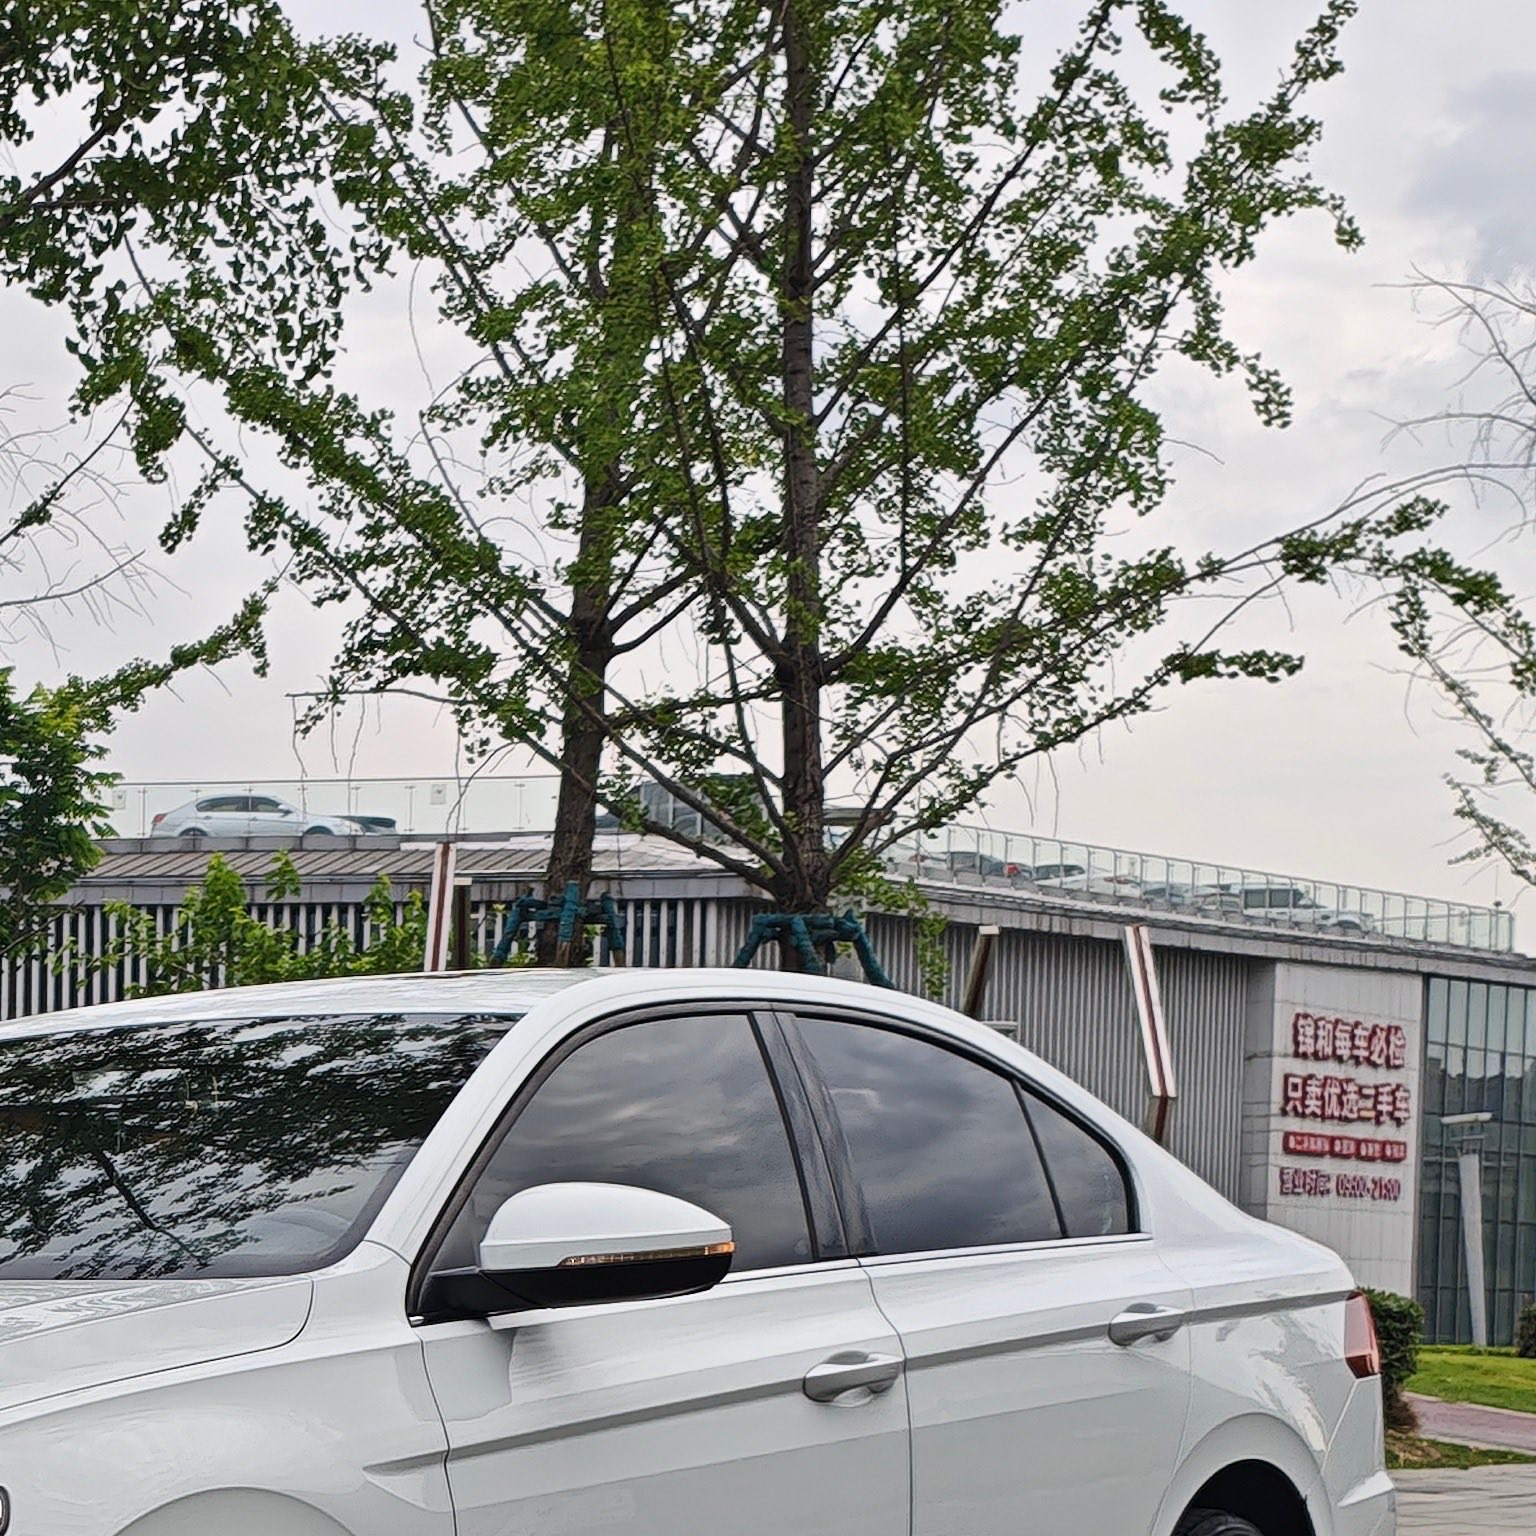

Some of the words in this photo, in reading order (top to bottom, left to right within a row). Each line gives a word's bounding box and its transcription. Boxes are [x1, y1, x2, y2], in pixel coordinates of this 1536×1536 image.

[1282, 1073, 1410, 1127] 只卖优选二手车
